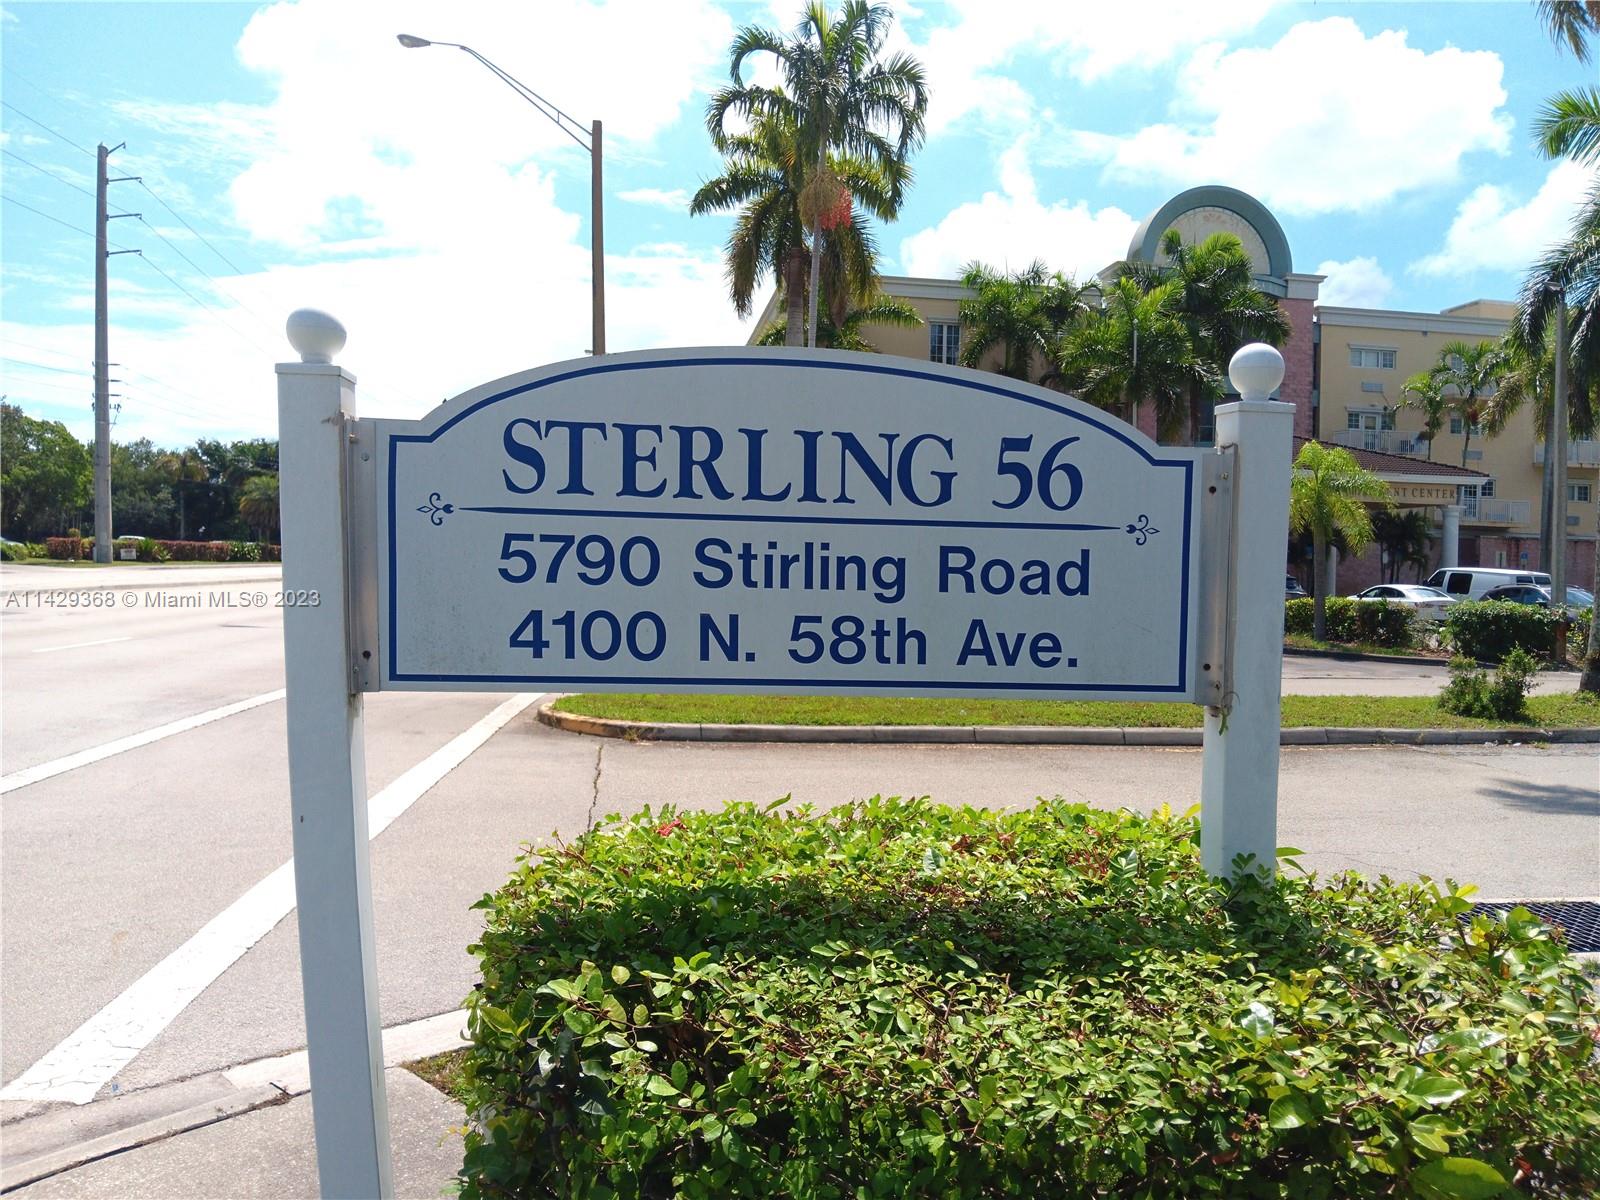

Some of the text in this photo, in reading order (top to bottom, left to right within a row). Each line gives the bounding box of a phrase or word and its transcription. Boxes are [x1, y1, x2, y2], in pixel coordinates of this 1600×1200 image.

[501, 417, 1084, 512] STERLING 56
[1411, 487, 1456, 500] CENTER
[498, 532, 1091, 605] 5790 Stirling Road
[509, 608, 1079, 669] 4100 N. 58th Ave.
